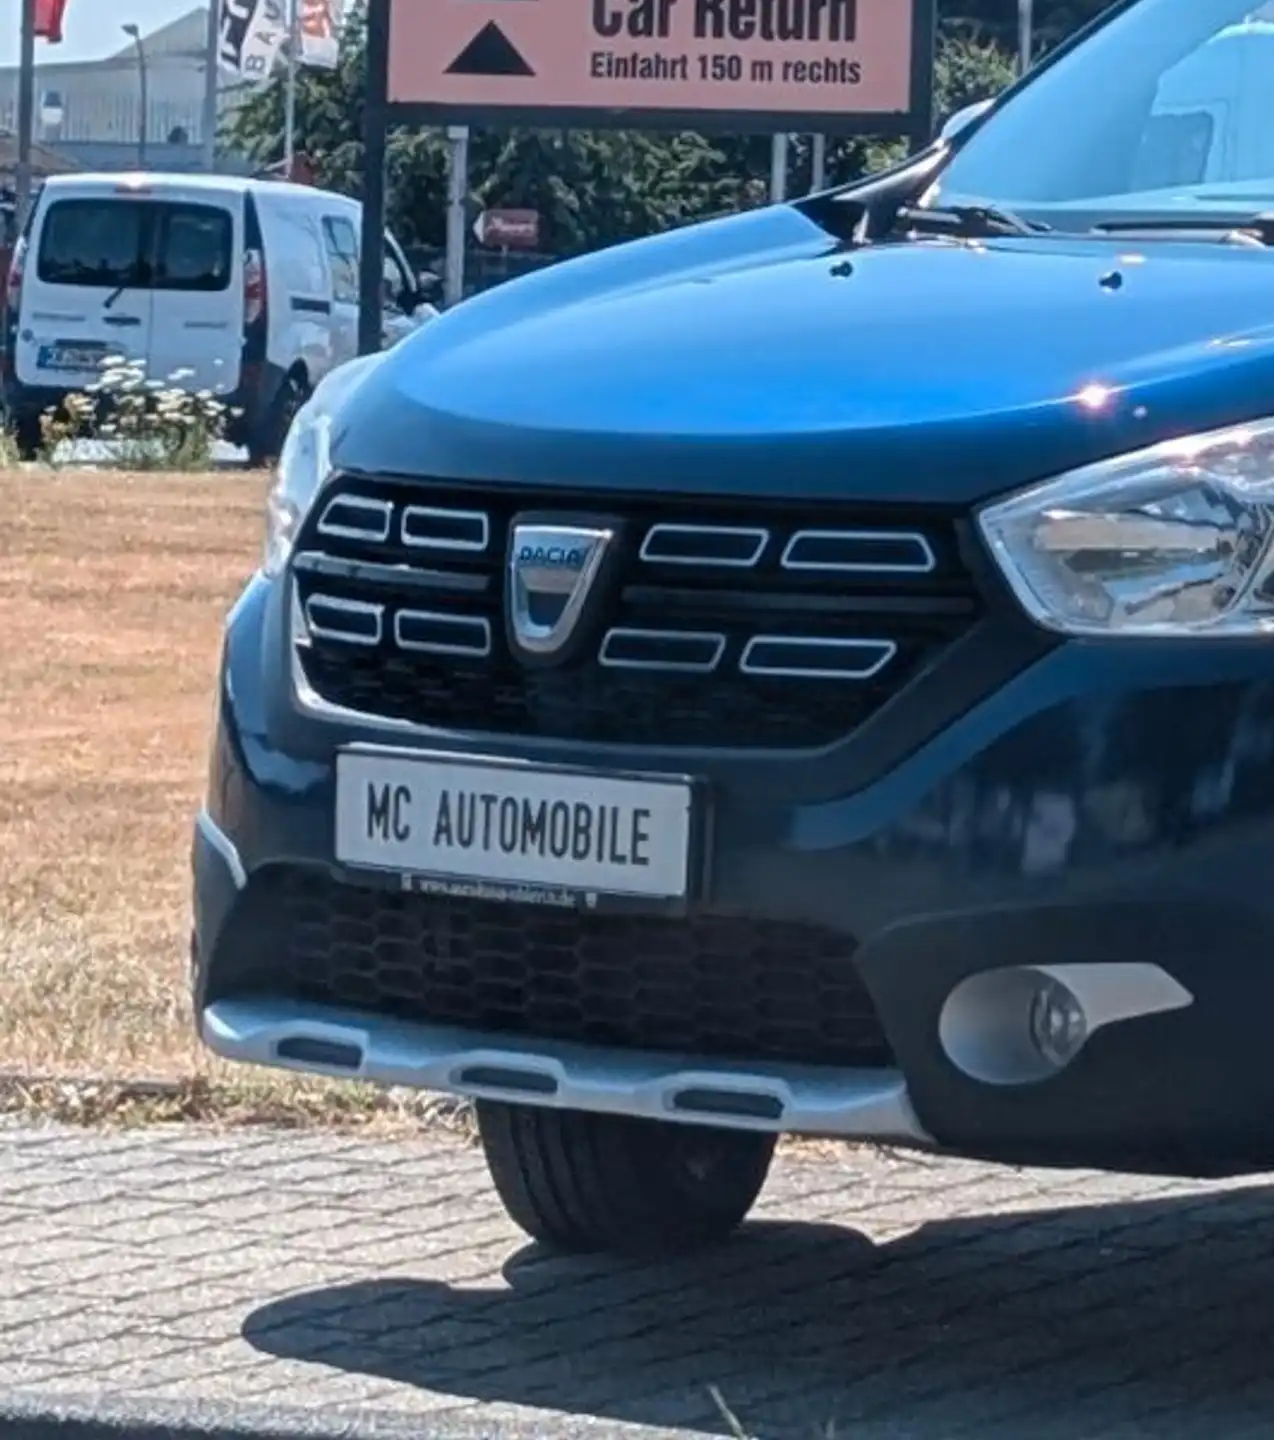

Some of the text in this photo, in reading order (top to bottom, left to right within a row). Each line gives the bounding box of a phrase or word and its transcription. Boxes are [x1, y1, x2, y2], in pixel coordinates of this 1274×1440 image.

[590, 51, 862, 85] Einfahrt 150 m rechts
[519, 545, 582, 566] DACIA
[366, 779, 651, 866] MC AUTOMOBILE
